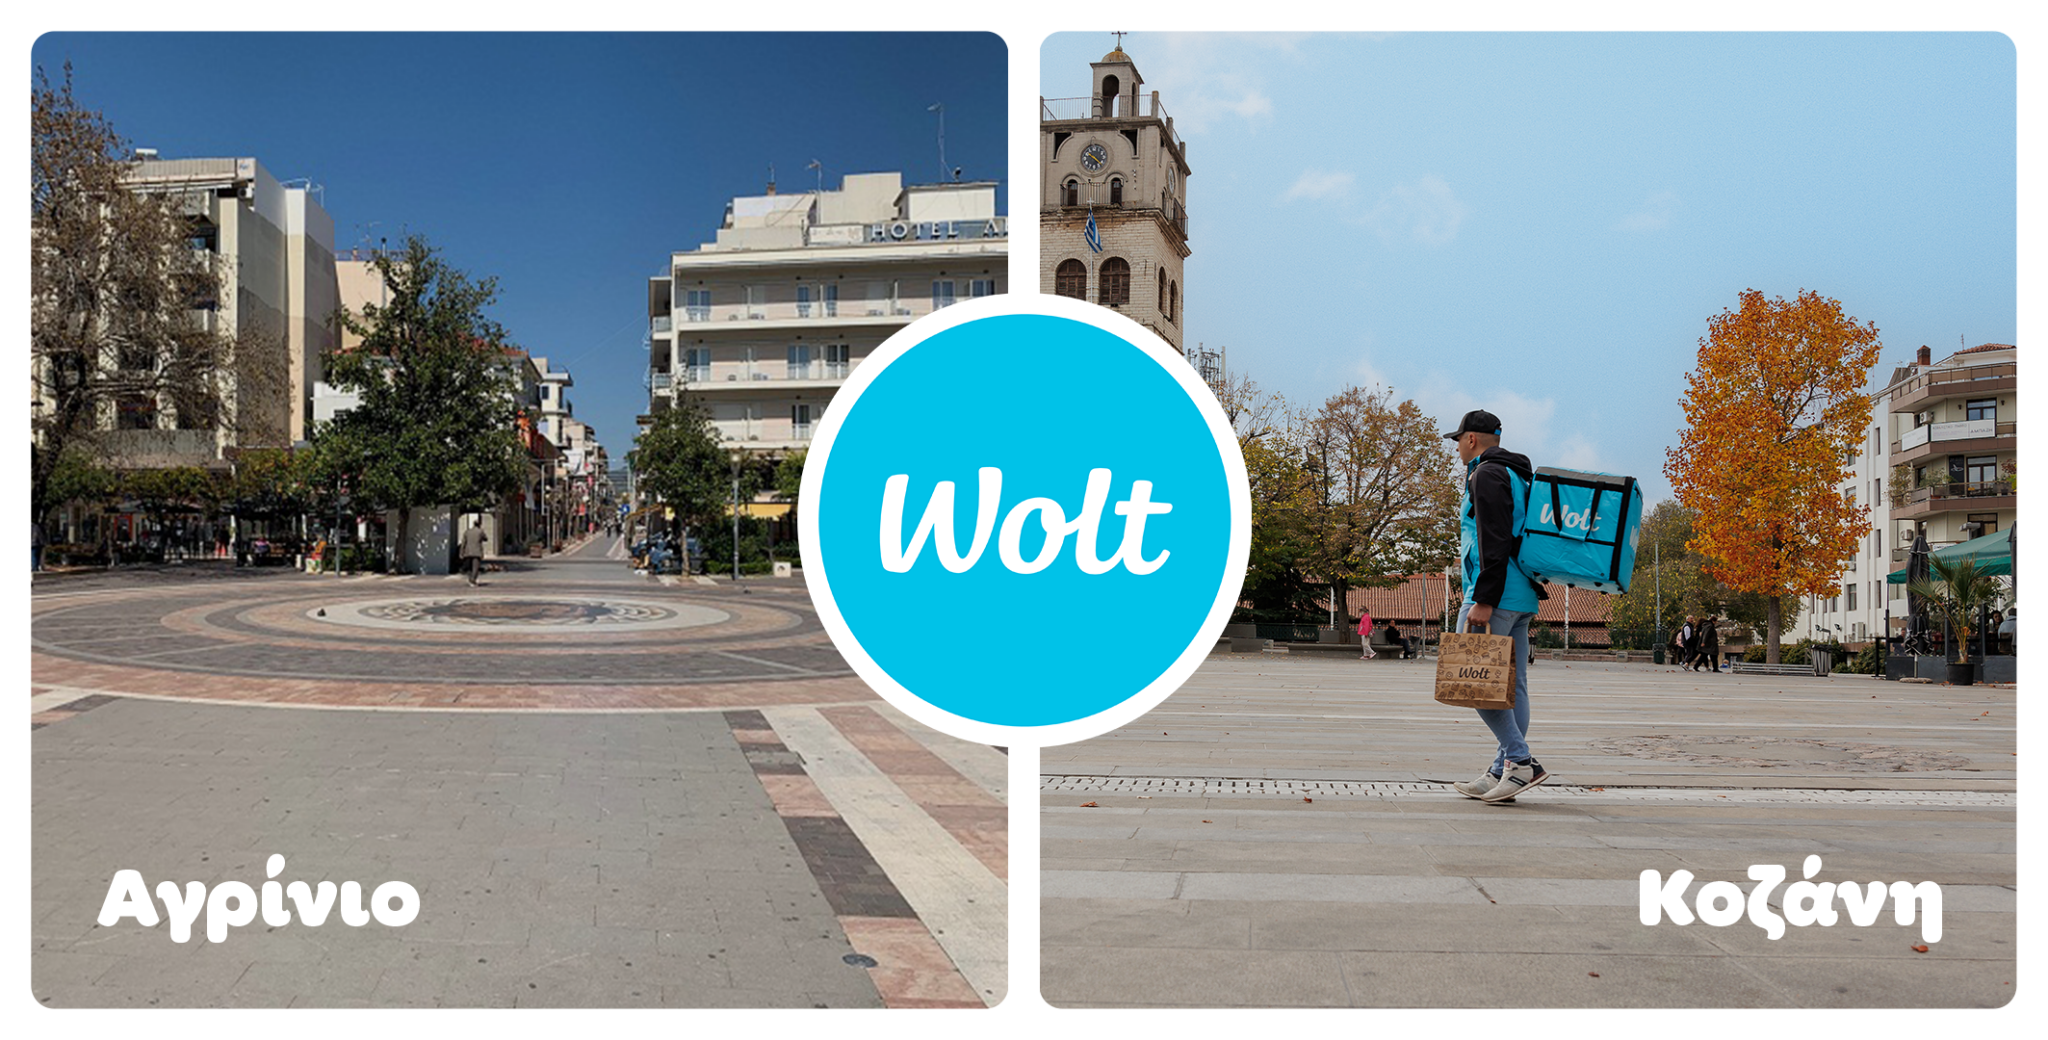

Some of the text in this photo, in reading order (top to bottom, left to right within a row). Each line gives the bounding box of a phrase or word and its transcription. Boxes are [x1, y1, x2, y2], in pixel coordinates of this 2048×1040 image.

[871, 218, 1009, 238] HOTEL A
[1540, 503, 1602, 532] Wolt
[1459, 667, 1491, 680] Wolt
